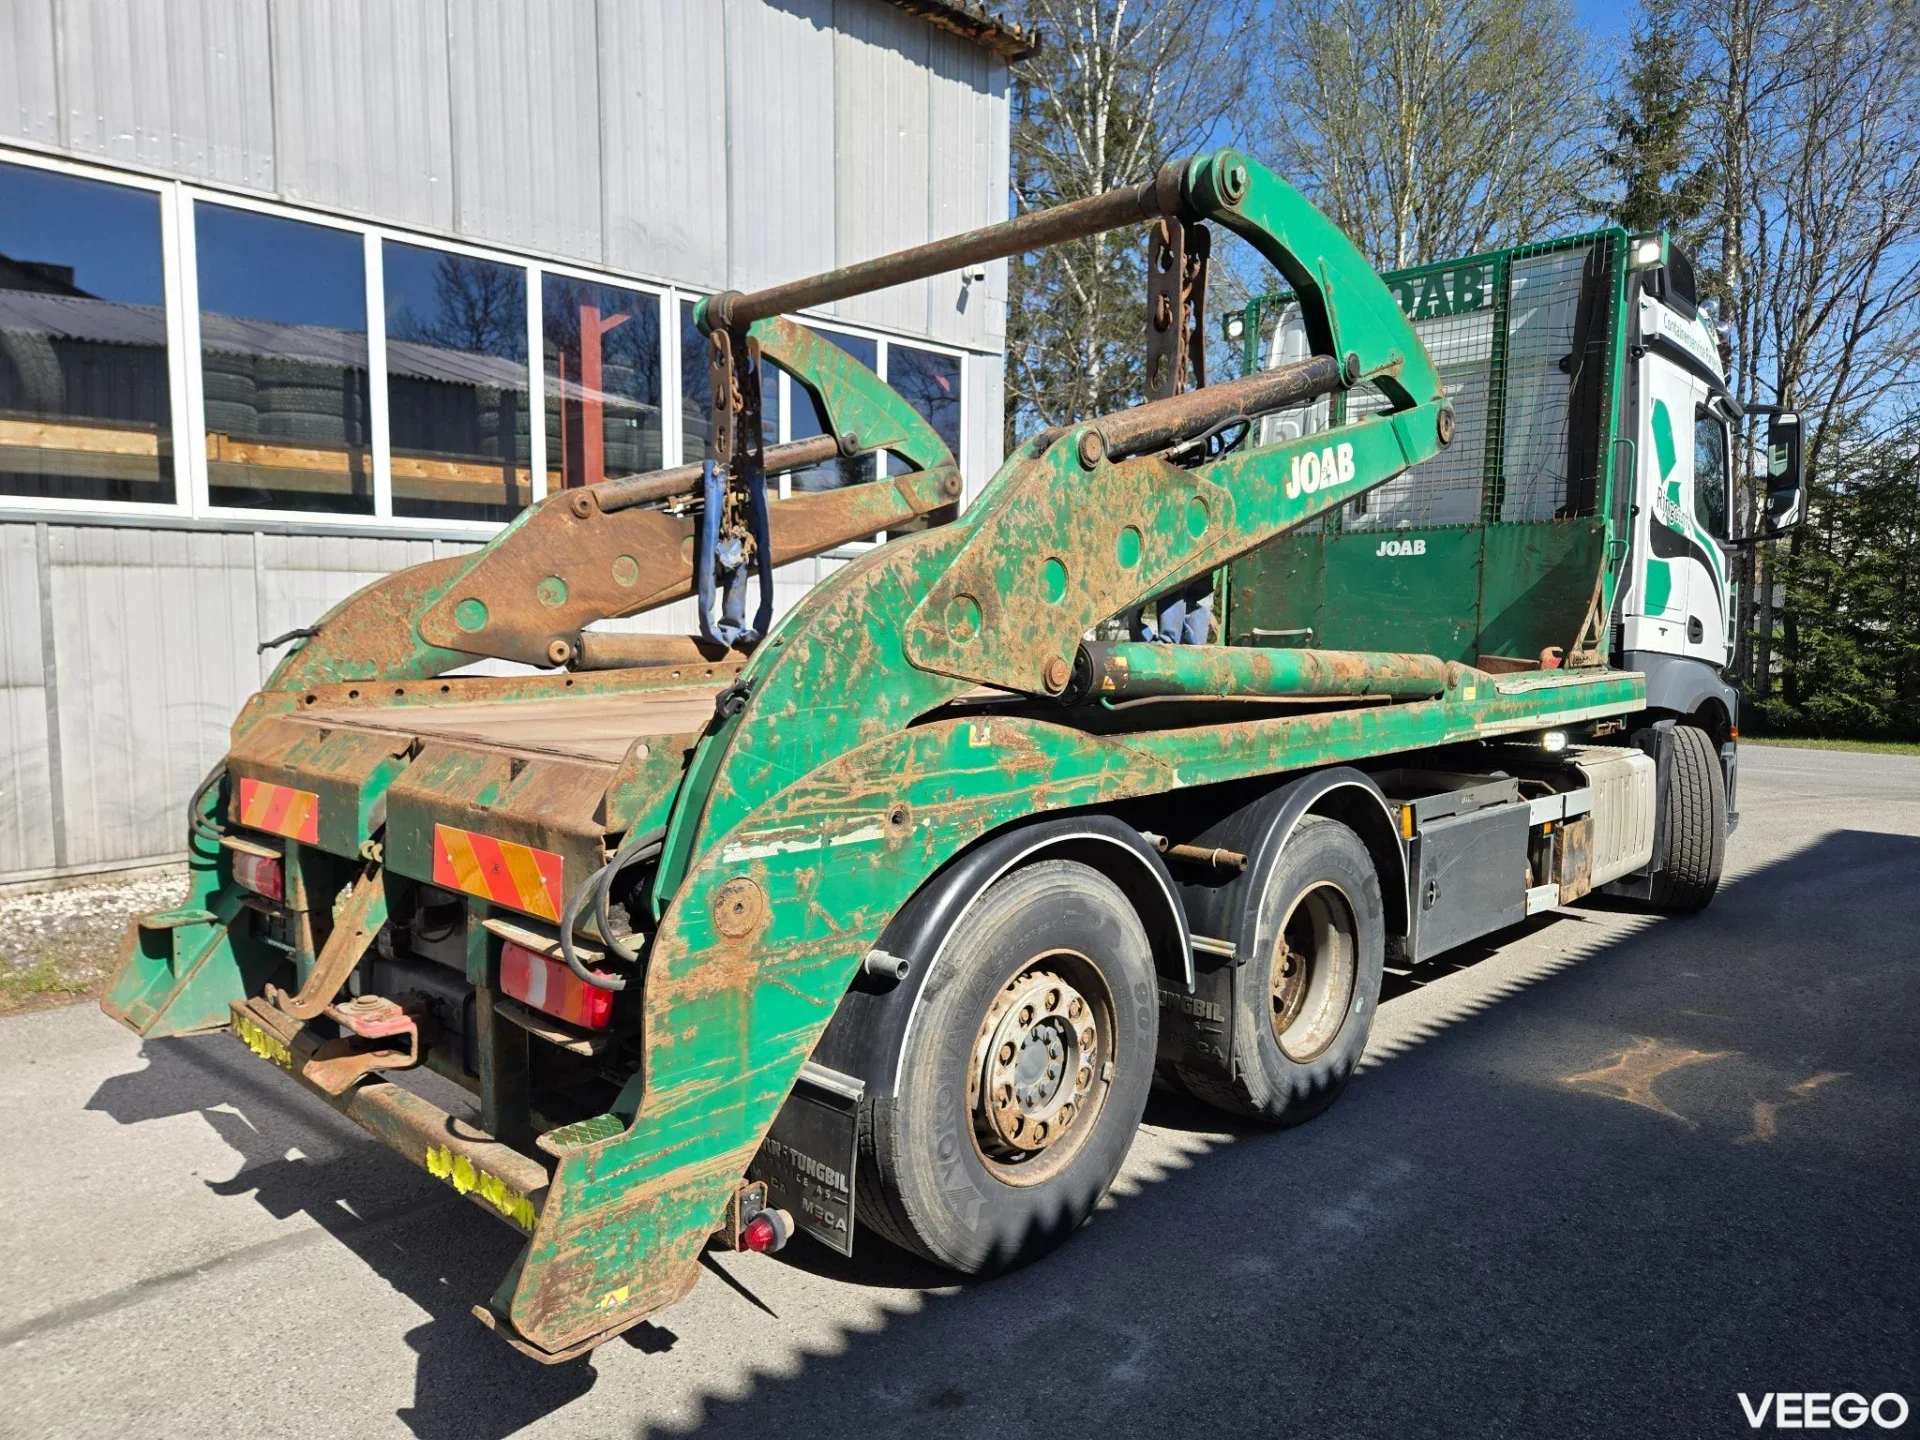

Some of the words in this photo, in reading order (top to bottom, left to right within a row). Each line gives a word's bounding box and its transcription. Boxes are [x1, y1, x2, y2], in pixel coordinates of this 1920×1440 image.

[1386, 266, 1484, 321] OAB
[1286, 442, 1355, 499] JOAB
[1376, 539, 1426, 557] JOAB
[936, 967, 997, 1188] YOKOHAMA
[789, 1147, 849, 1194] TUNGBIL
[802, 1197, 848, 1233] MECA
